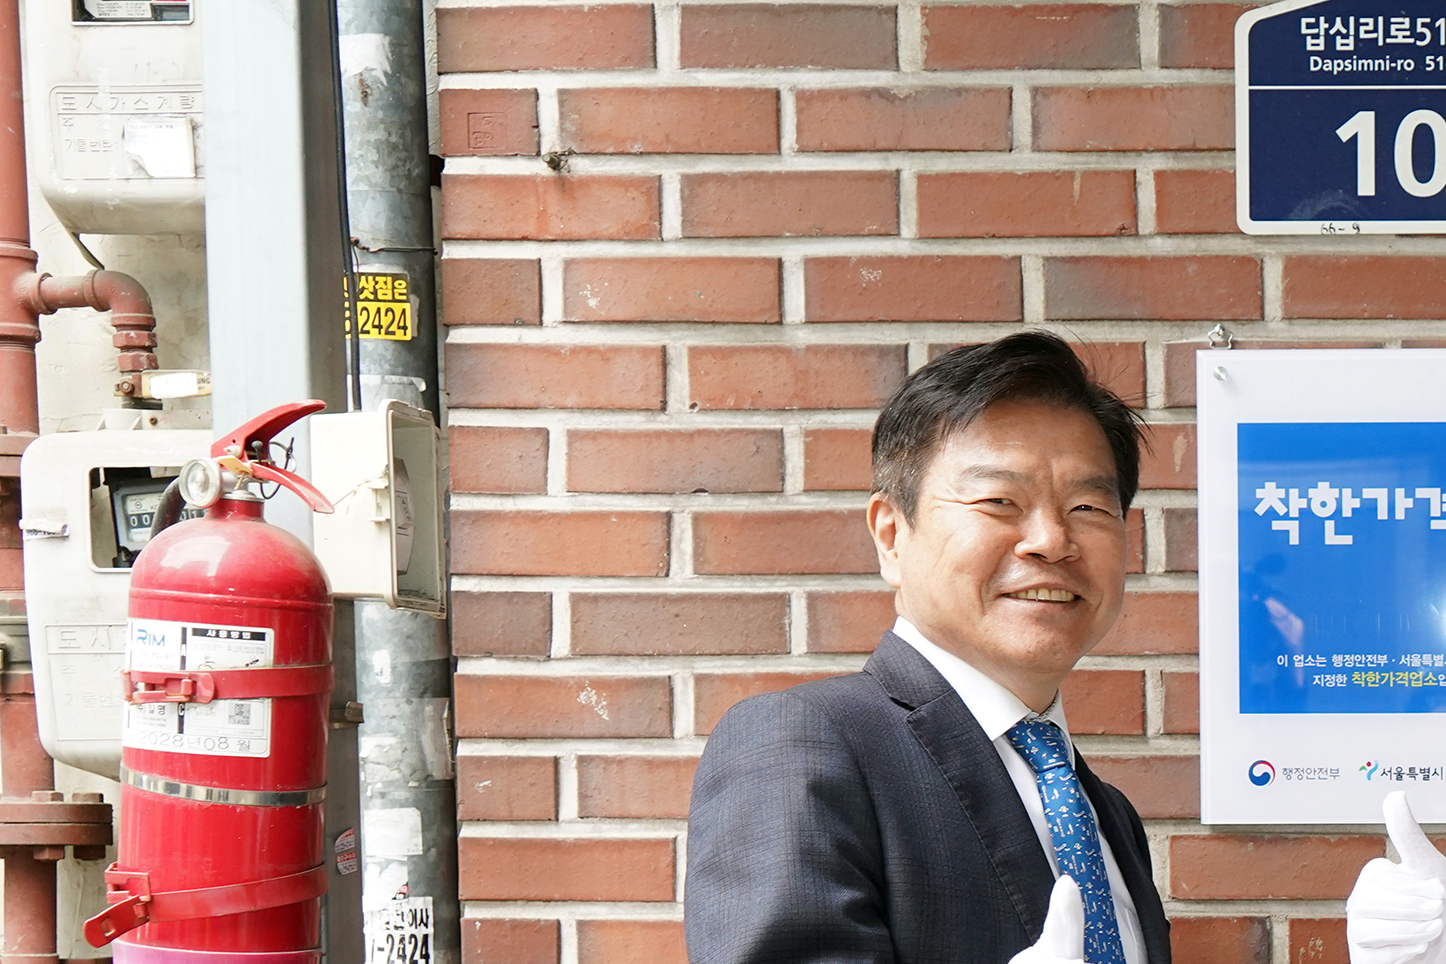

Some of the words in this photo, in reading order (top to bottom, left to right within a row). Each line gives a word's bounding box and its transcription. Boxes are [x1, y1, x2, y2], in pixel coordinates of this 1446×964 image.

[1310, 56, 1415, 74] Dapsimni-ro
[1277, 655, 1288, 667] 이
[1293, 654, 1327, 667] 업소는
[1332, 654, 1388, 667] 행정안전부
[1313, 674, 1347, 687] 지정한
[1282, 767, 1340, 780] 행정안전부
[1380, 766, 1444, 781] 서울특별시
